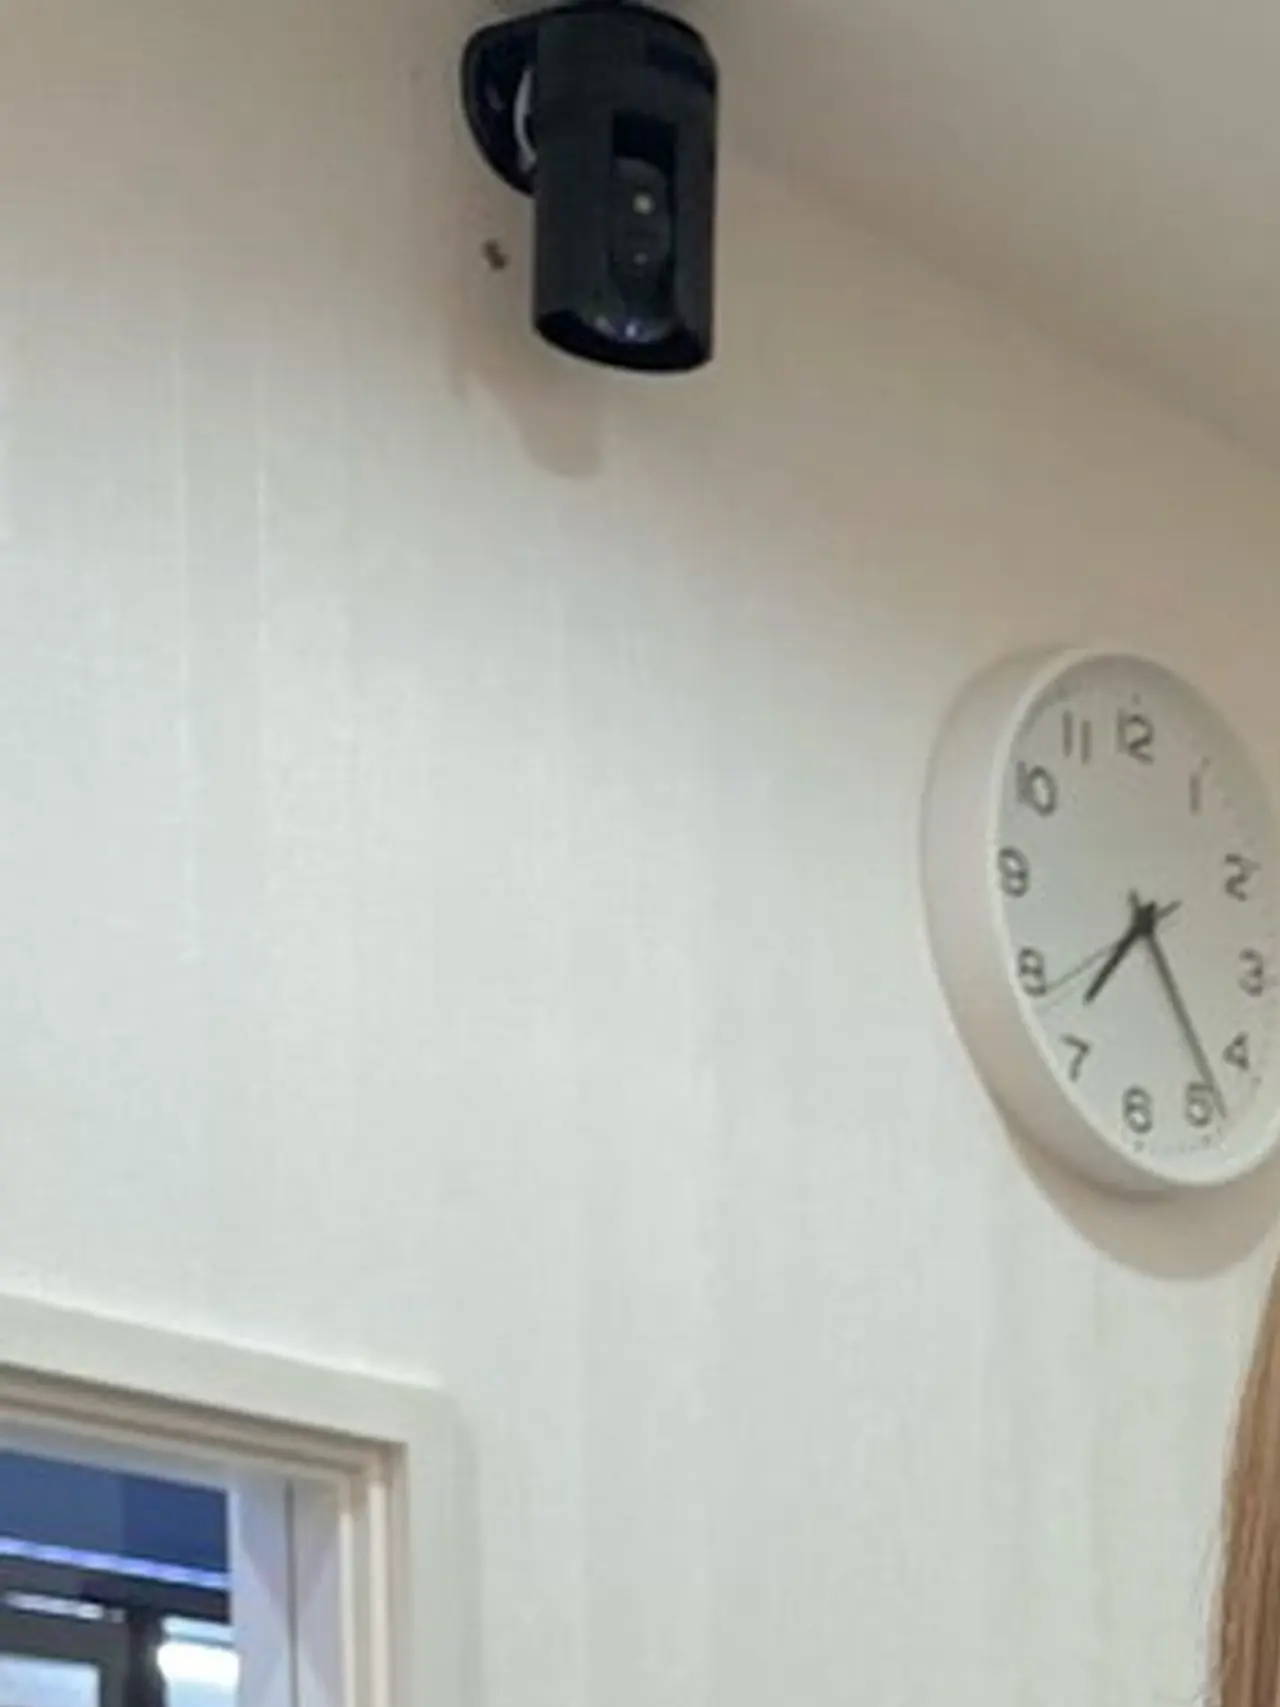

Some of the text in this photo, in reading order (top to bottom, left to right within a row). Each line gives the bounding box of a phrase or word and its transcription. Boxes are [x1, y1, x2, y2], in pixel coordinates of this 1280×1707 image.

[1062, 711, 1091, 764] 11
[1117, 711, 1153, 763] 12
[1016, 762, 1057, 816] 10
[1224, 854, 1250, 900] 2
[1238, 949, 1264, 996] 3
[1061, 1035, 1090, 1081] 7
[1224, 1033, 1250, 1070] 4
[1122, 1086, 1153, 1134] 6
